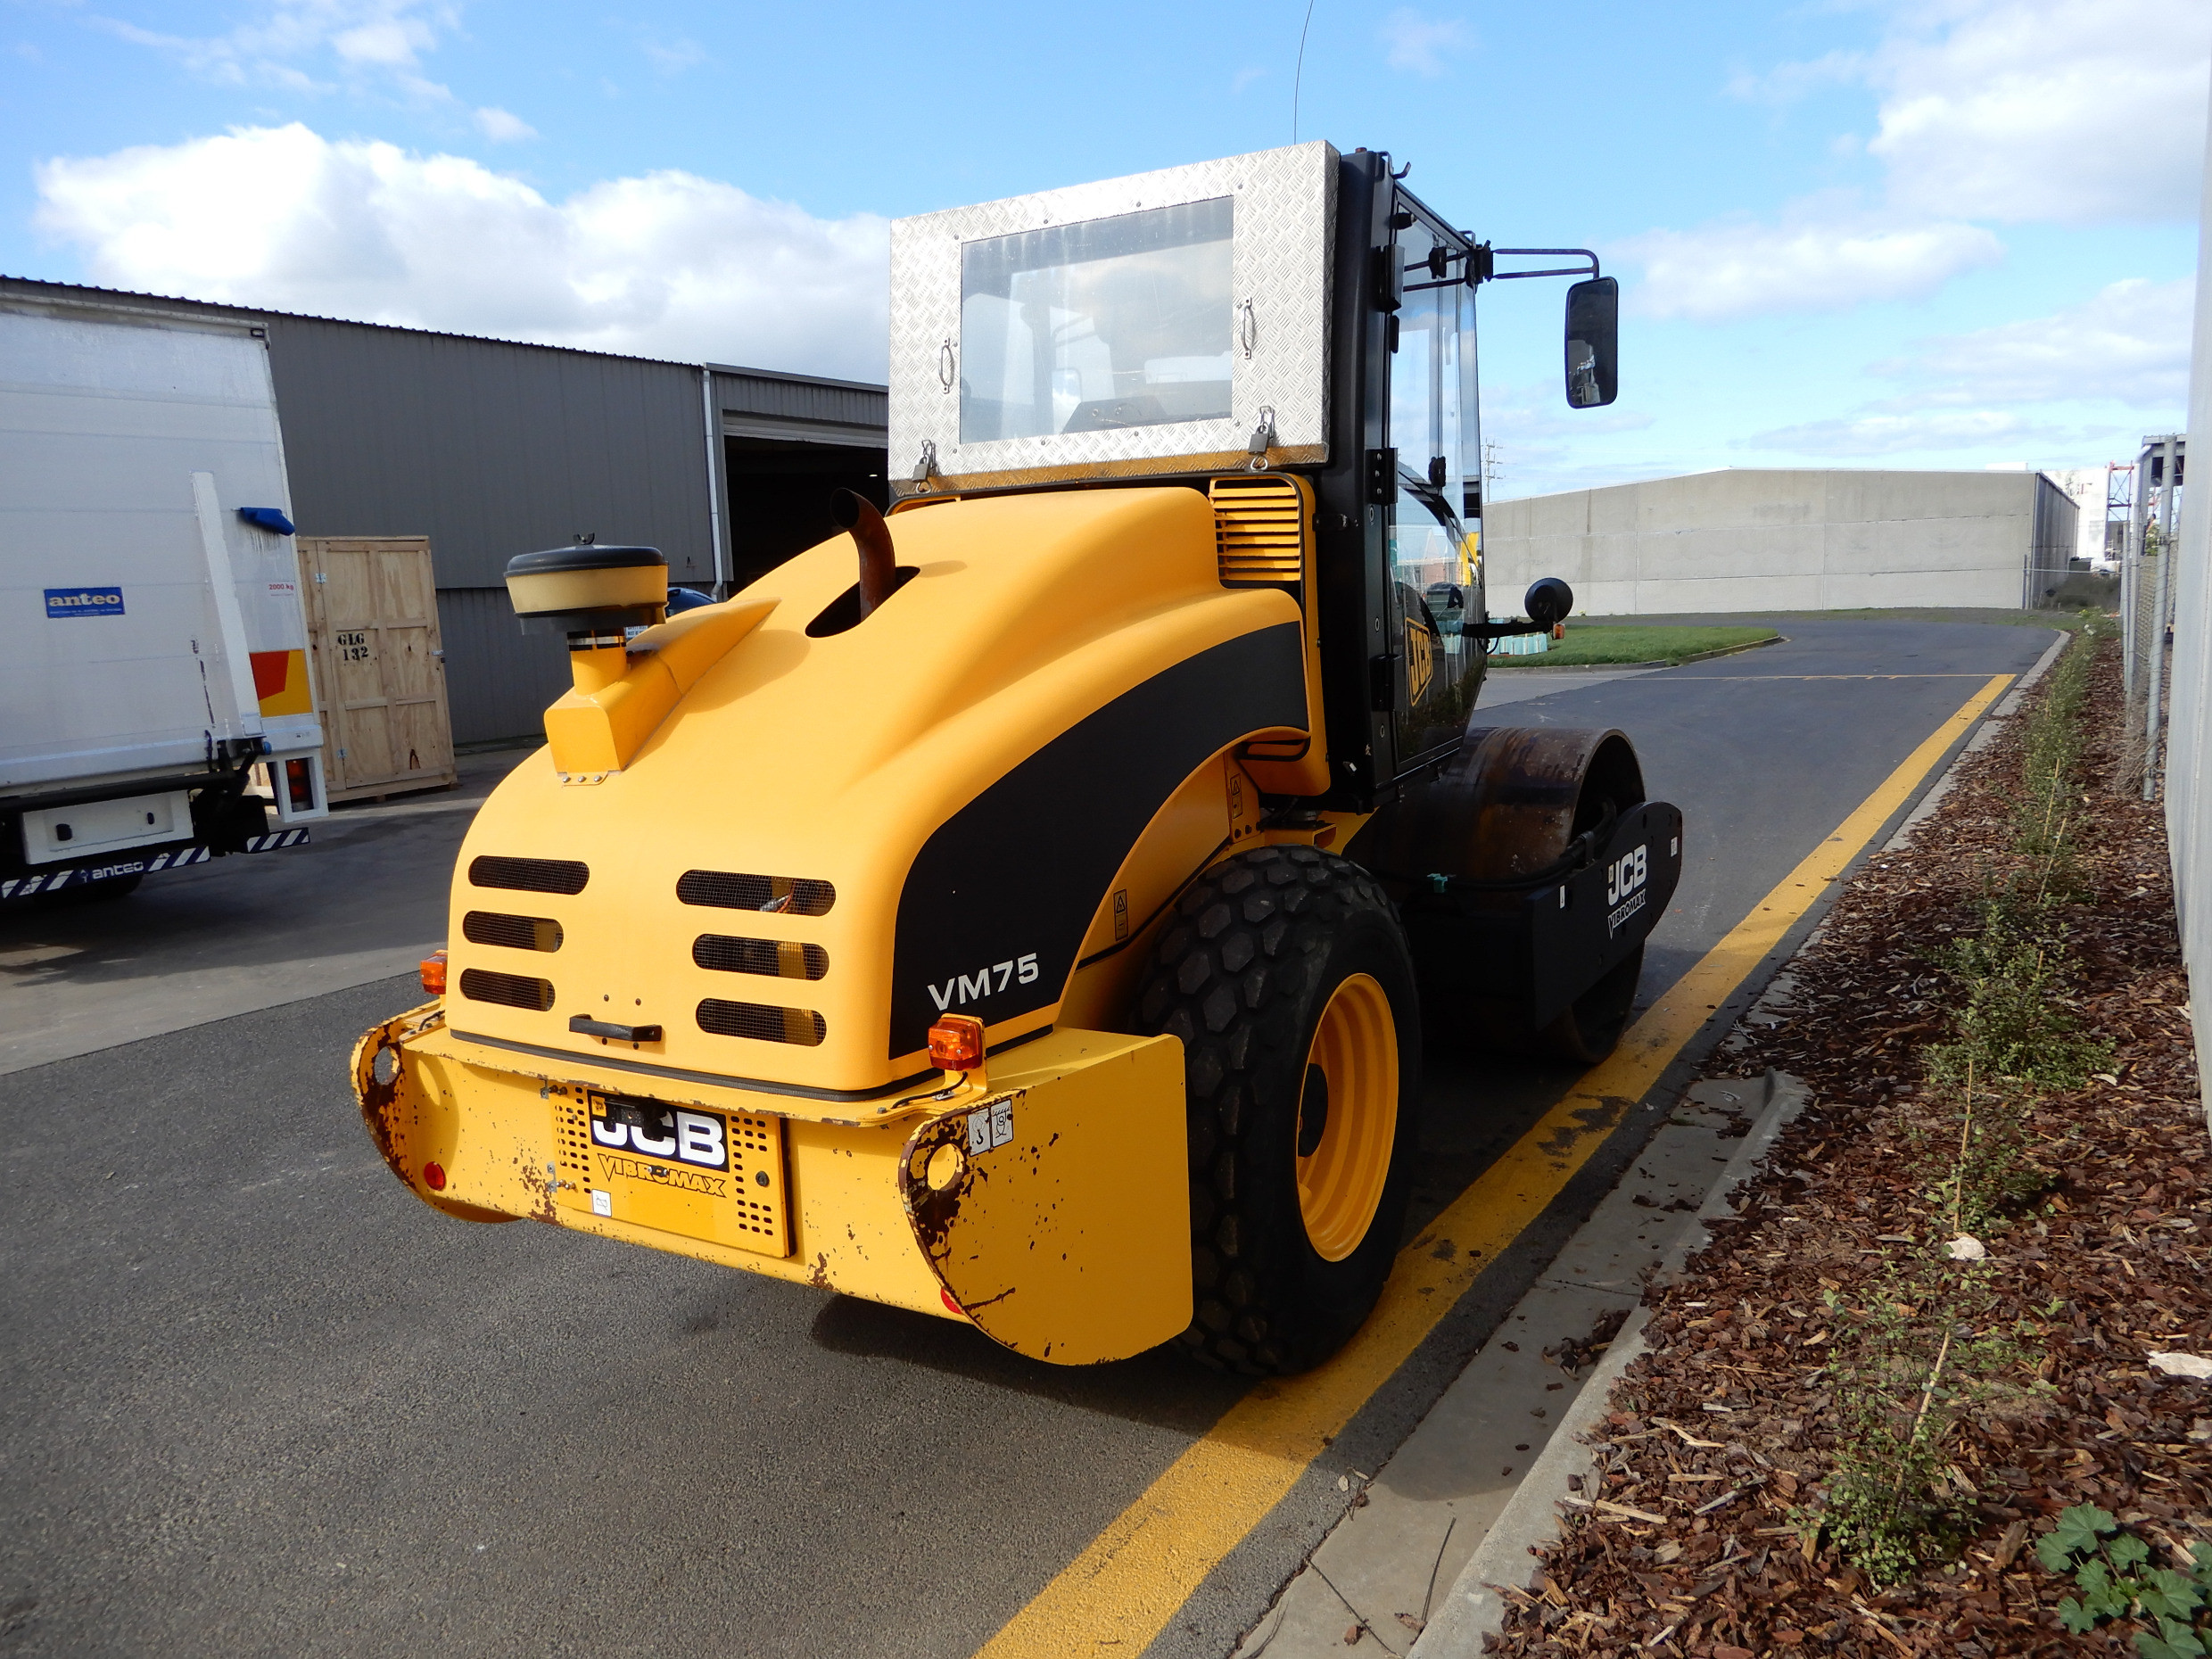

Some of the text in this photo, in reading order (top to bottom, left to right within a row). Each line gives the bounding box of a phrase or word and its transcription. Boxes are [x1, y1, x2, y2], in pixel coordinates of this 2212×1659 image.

[49, 592, 120, 607] anteo
[343, 646, 368, 661] 132
[1409, 627, 1432, 696] JCB
[92, 861, 144, 879] anteo
[1607, 844, 1647, 906] JCB
[1607, 887, 1647, 940] VIBROMAX
[927, 952, 1039, 1011] VM75
